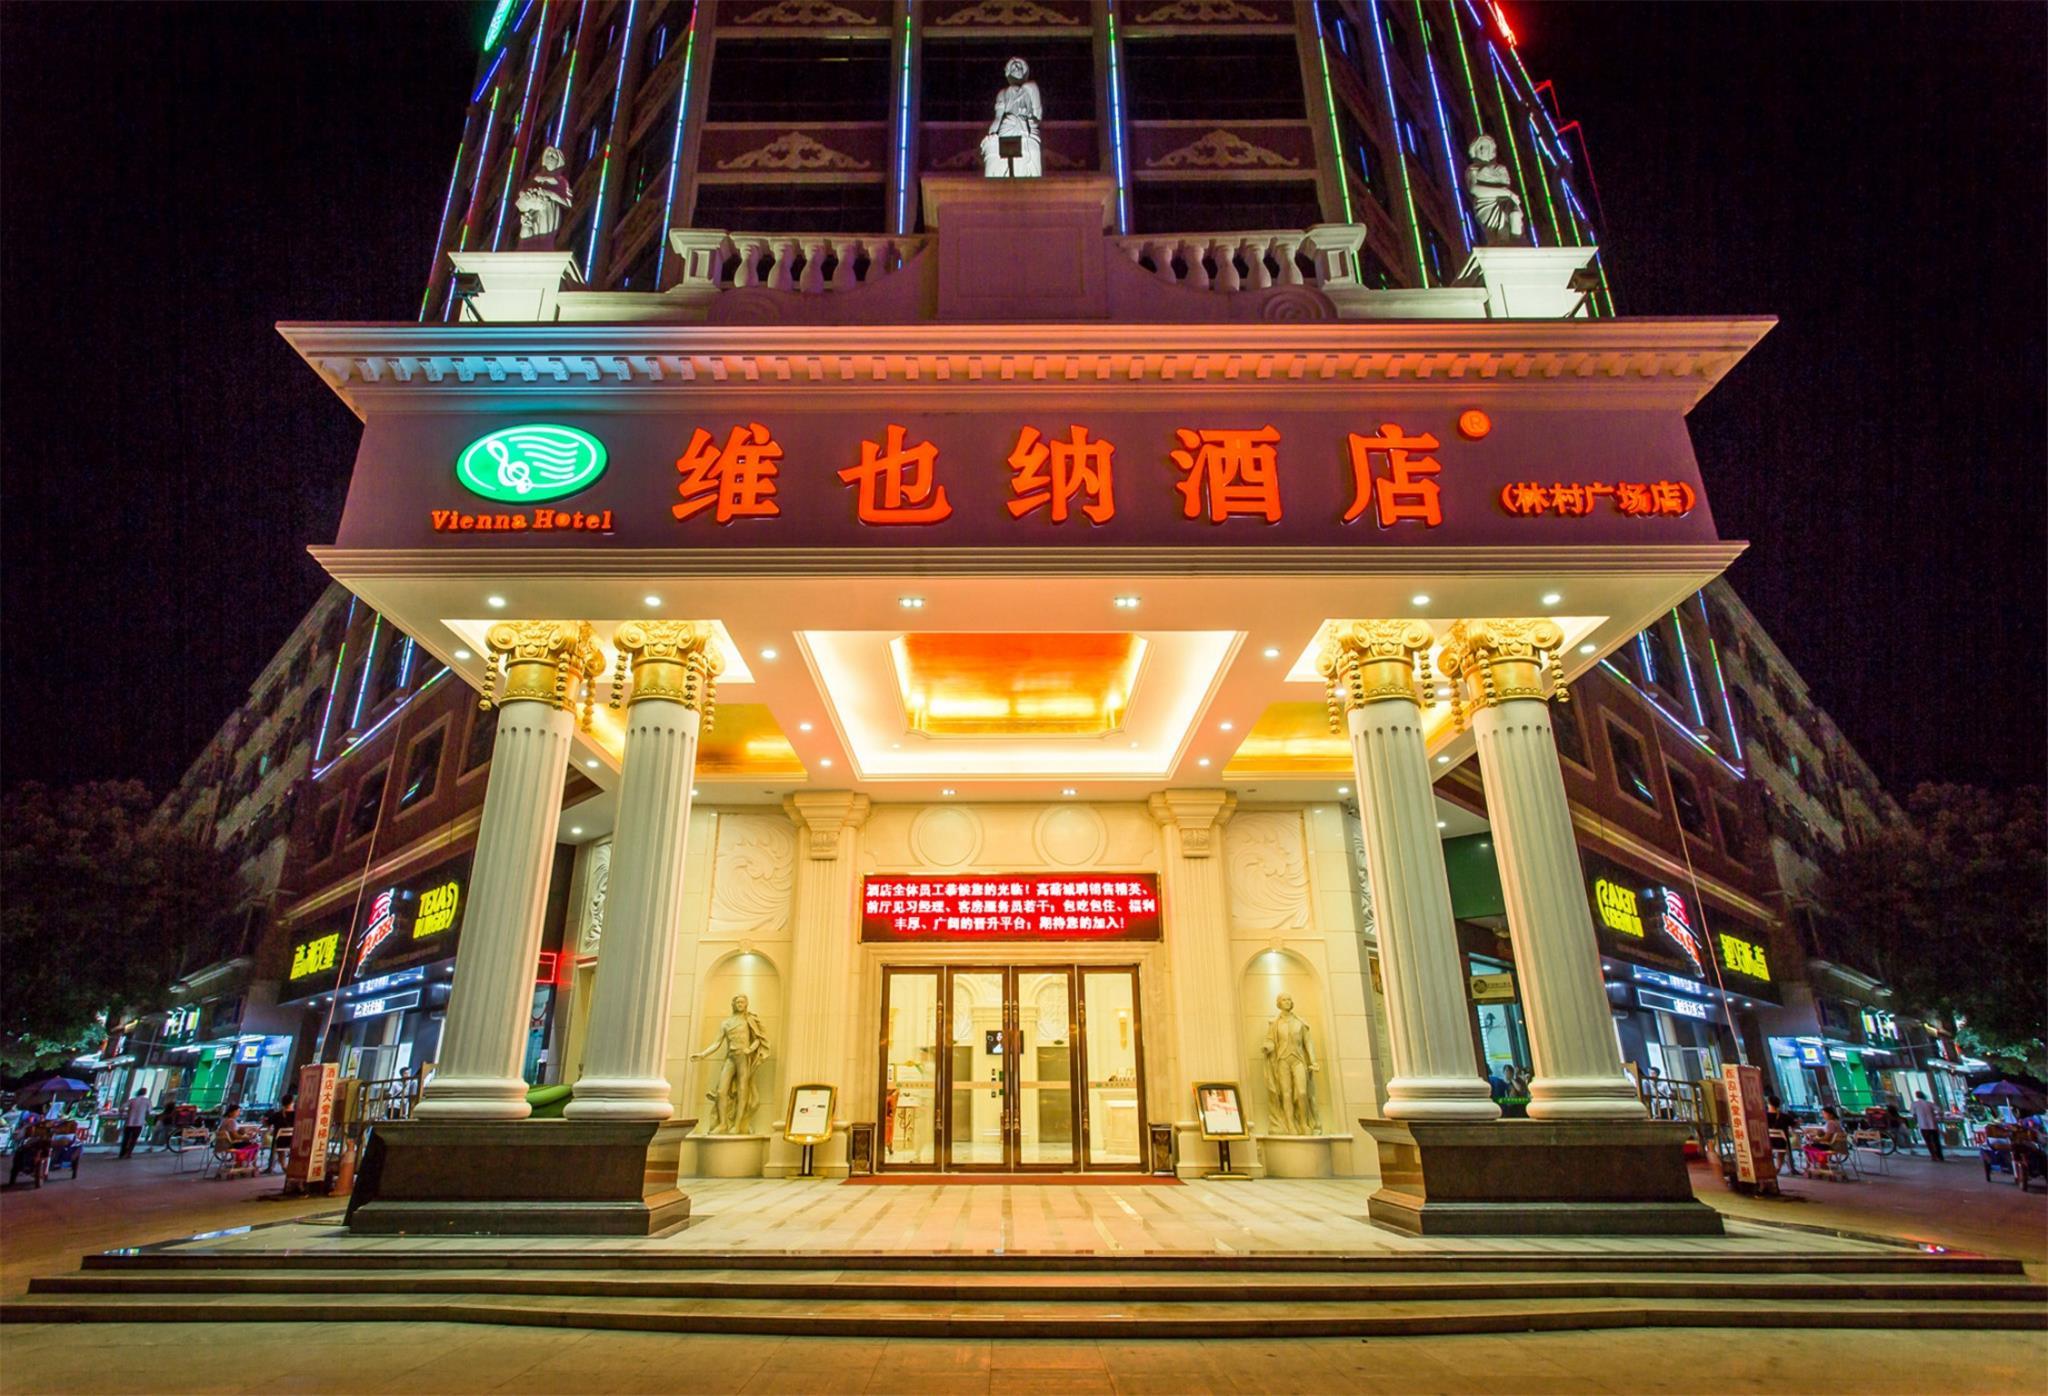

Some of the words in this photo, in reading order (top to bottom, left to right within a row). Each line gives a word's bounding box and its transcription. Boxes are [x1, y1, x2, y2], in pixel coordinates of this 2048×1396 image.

[671, 422, 1443, 528] 维也纳酒店
[431, 510, 528, 531] Vienna
[532, 509, 613, 530] Hotel
[418, 882, 459, 920] TEXAS
